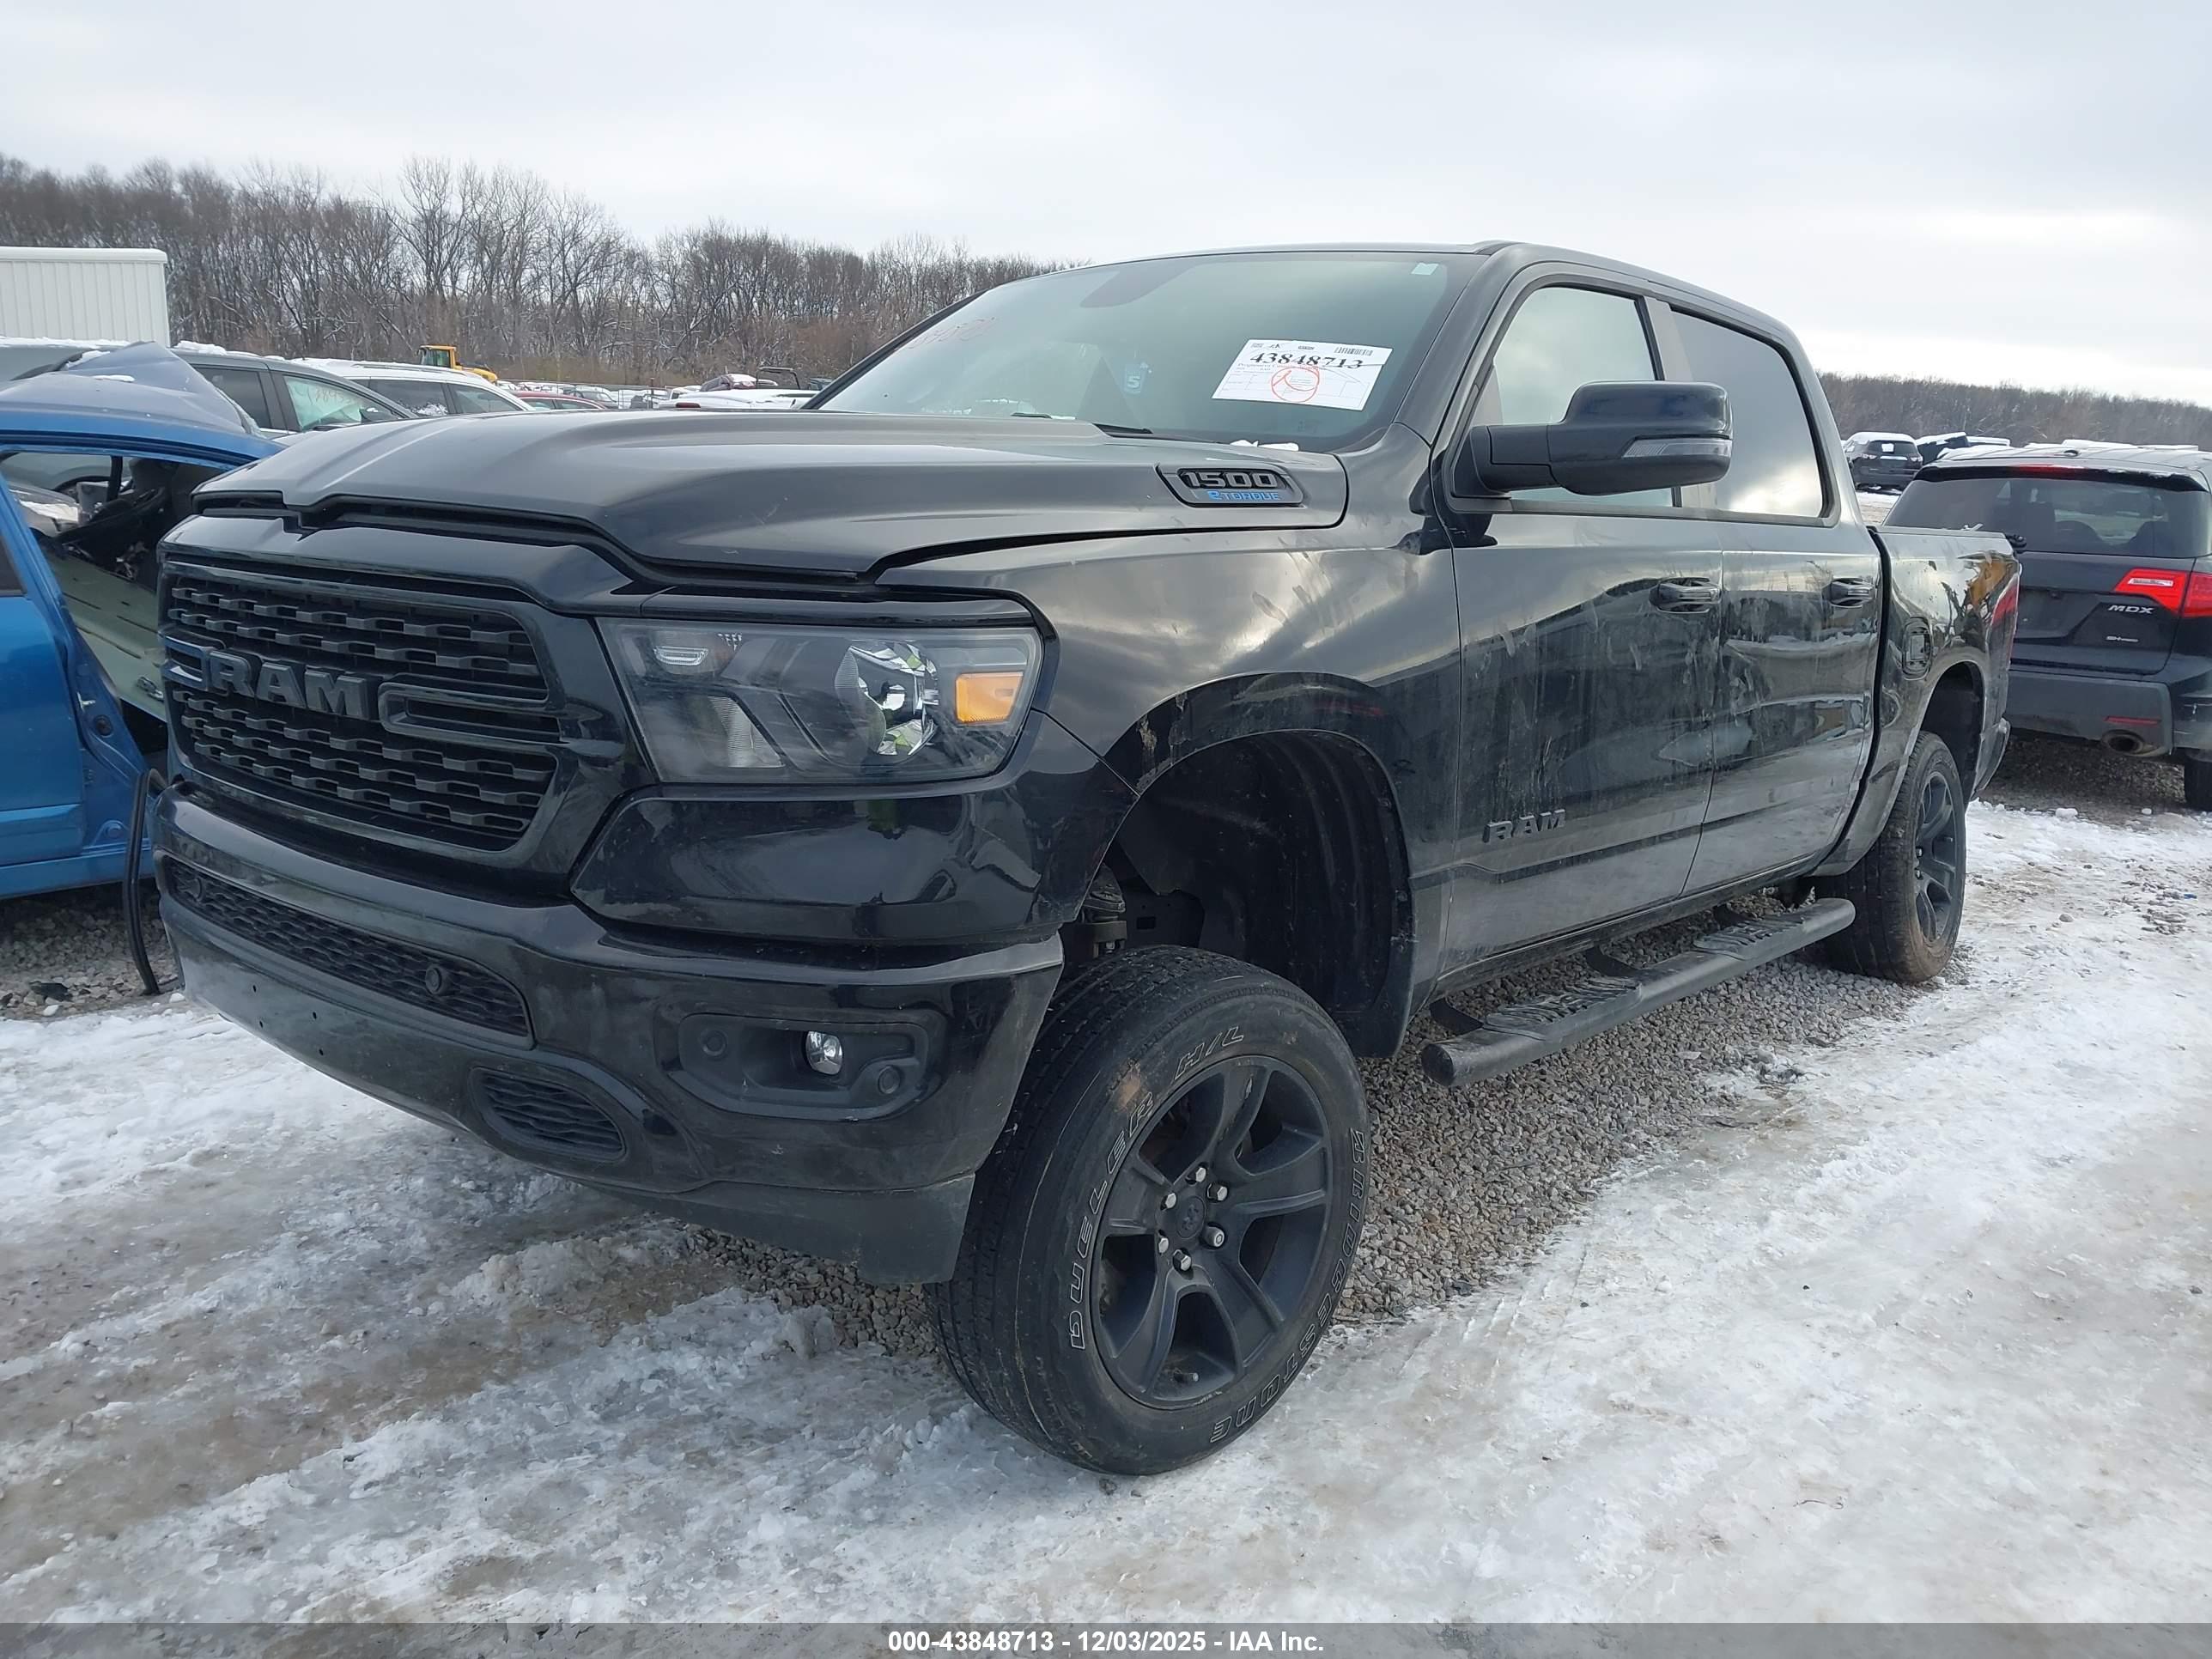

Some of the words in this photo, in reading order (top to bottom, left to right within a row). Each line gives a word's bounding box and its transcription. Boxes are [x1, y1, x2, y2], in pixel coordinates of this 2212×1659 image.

[1249, 352, 1364, 369] 43848713
[1185, 471, 1279, 489] 1500
[2107, 605, 2155, 614] MDX
[208, 649, 370, 720] RAM
[1481, 808, 1566, 845] RAM
[1070, 1091, 1154, 1351] DUELER
[1175, 1025, 1244, 1080] H/L
[1209, 1127, 1364, 1443] BRIDGESTONE
